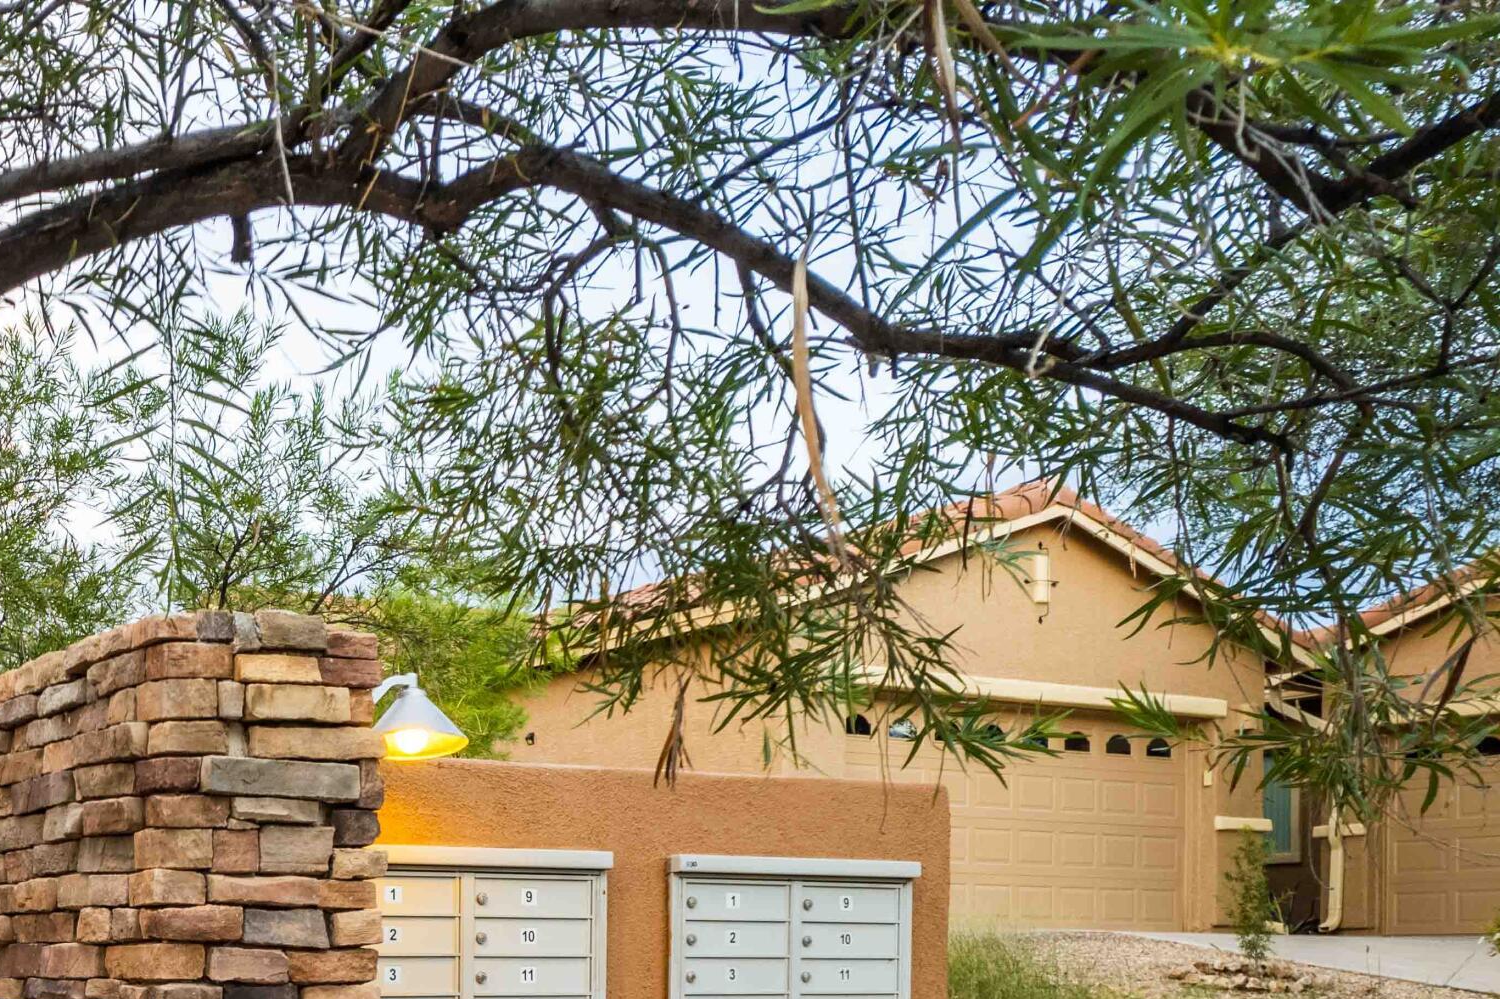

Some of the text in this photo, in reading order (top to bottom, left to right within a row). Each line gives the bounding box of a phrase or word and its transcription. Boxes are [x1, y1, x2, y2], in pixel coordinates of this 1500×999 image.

[525, 890, 533, 903] 9
[843, 897, 850, 909] 9
[389, 928, 398, 941] 2
[522, 930, 535, 943] 10
[729, 931, 736, 944] 2
[840, 933, 851, 945] 10
[389, 967, 397, 982] 3
[521, 968, 534, 982] 11
[729, 968, 736, 981] 3
[839, 969, 850, 980] 11
